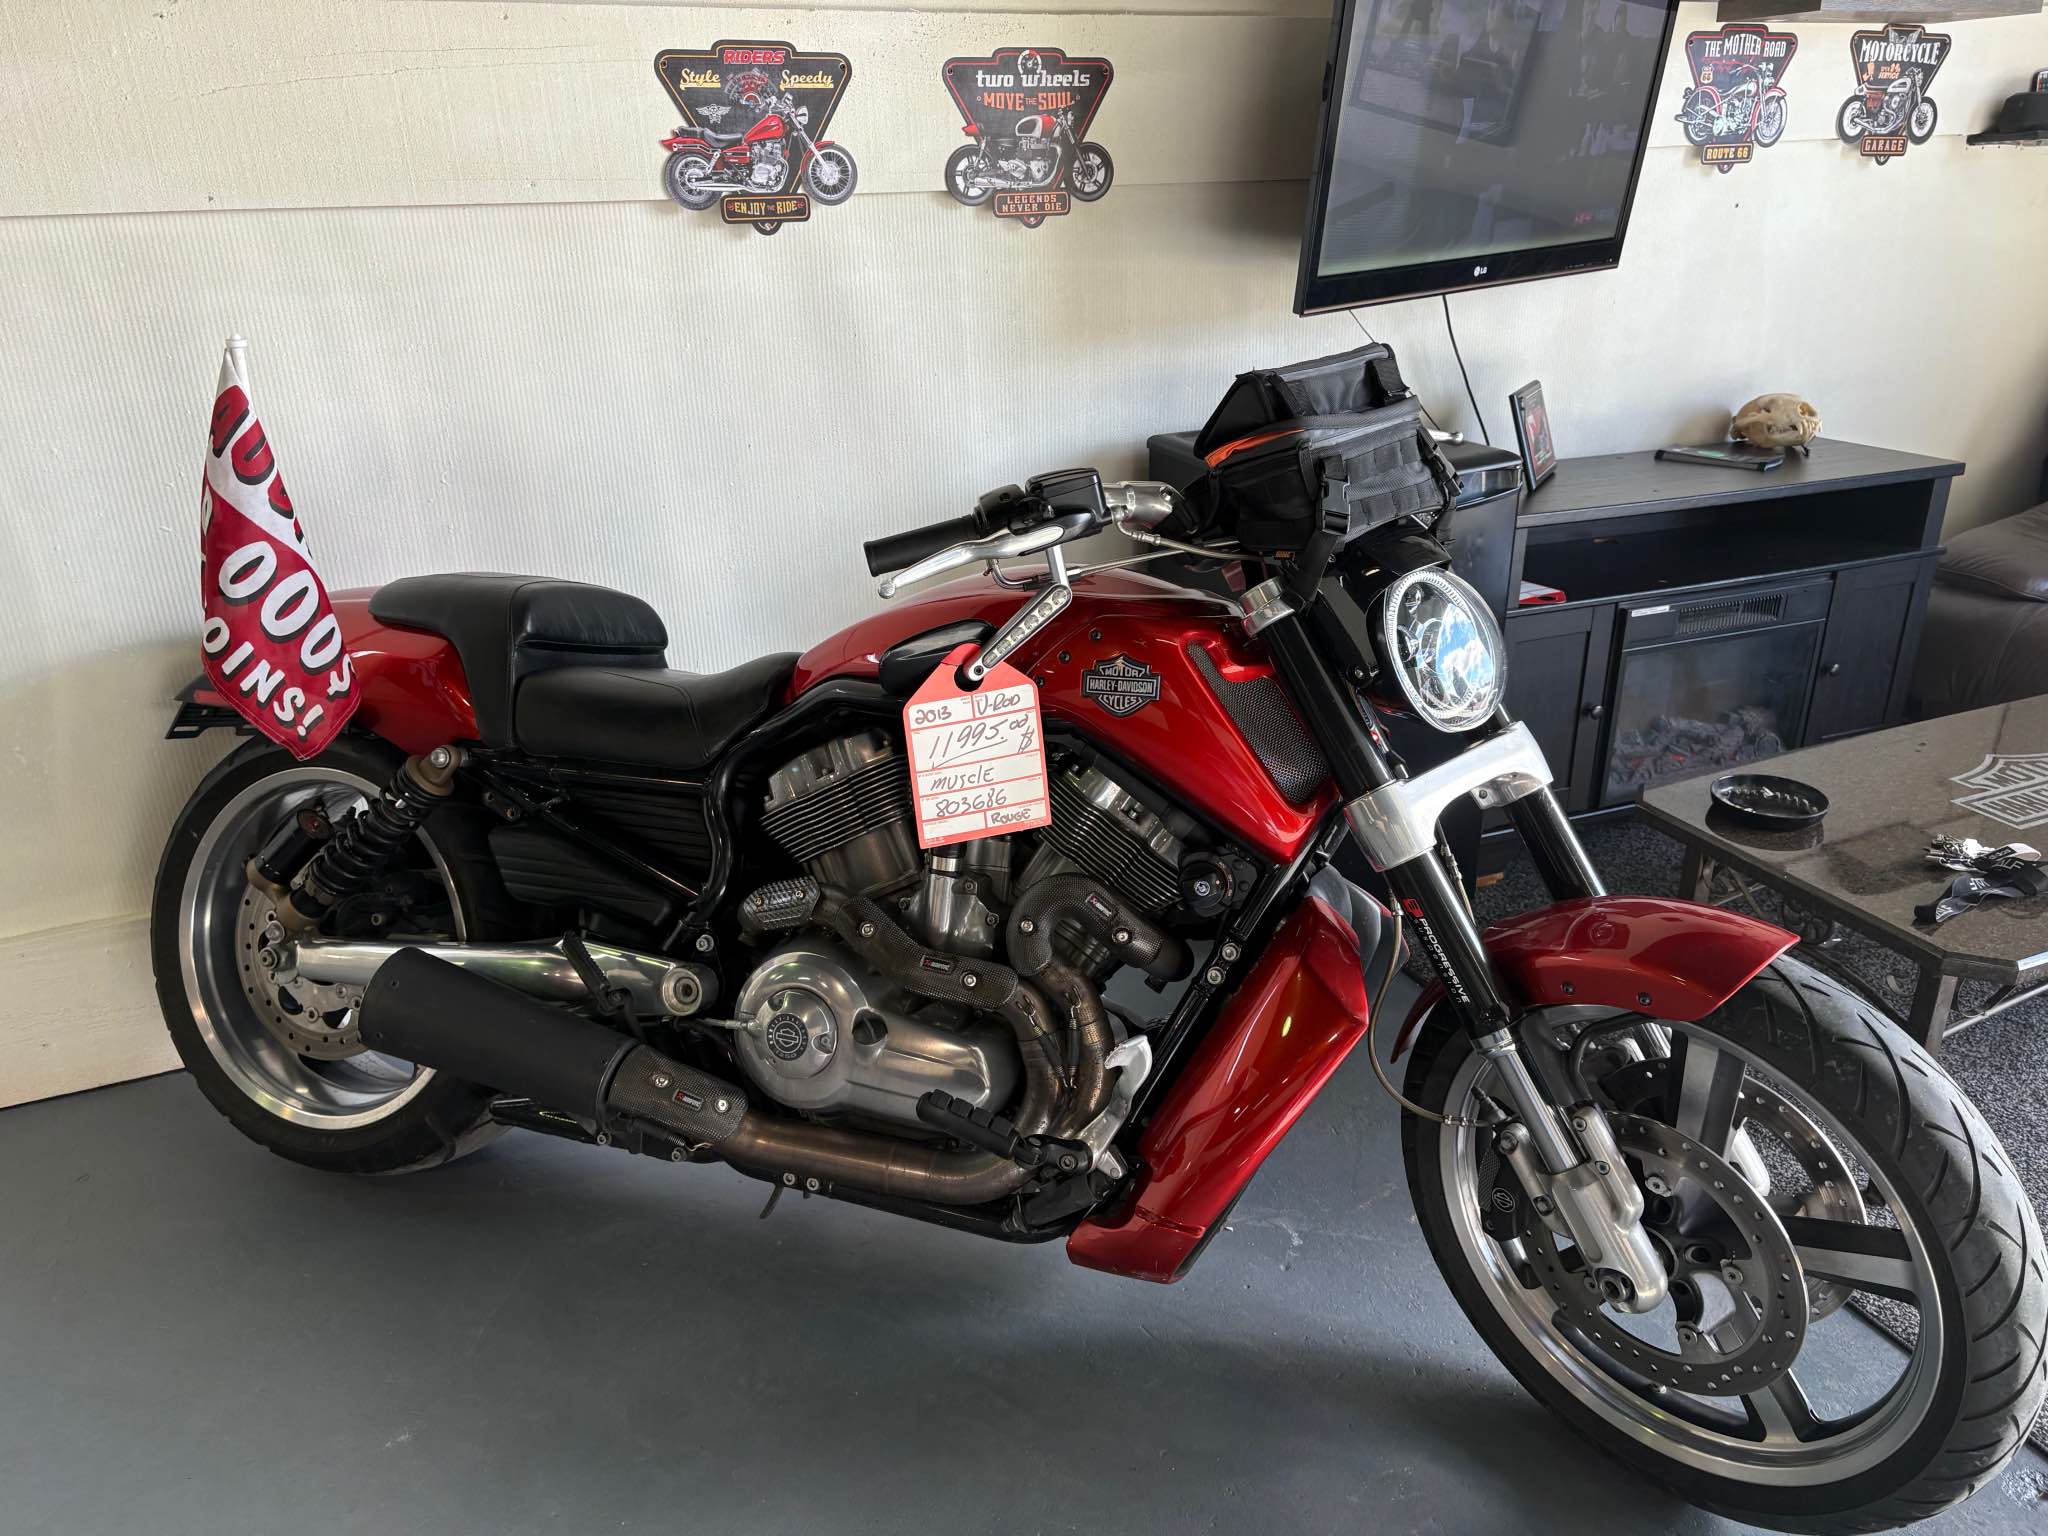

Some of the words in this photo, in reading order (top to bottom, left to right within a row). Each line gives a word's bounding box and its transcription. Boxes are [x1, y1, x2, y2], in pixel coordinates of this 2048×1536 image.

[1704, 40, 1723, 58] THE
[1723, 33, 1762, 56] MOTHER
[1763, 41, 1787, 58] ROAD
[1859, 39, 1941, 65] MOTORCYCLE
[723, 49, 785, 65] RIDERS
[680, 68, 721, 86] Style
[780, 69, 834, 87] Speedy
[976, 69, 1014, 88] two
[1020, 69, 1091, 87] wheels
[983, 92, 1025, 111] MOVE
[1025, 97, 1037, 105] THE
[1037, 91, 1073, 111] SOUL
[1706, 148, 1735, 159] ROUTE
[1736, 147, 1748, 158] 66
[1864, 139, 1904, 151] GARAGE
[734, 201, 766, 215] ENJOY
[776, 200, 798, 214] RIDE
[1007, 194, 1057, 204] LEGENDS
[1002, 203, 1038, 213] NEVER
[1044, 203, 1062, 211] DIE
[203, 616, 325, 738] OINS!
[1105, 664, 1140, 678] MOTOR
[1089, 678, 1153, 694] HARLEY-DAVIDSON
[1103, 694, 1137, 710] CYCLES
[914, 705, 952, 725] 2013
[935, 788, 1007, 818] 803686
[990, 808, 1031, 825] ROUGE
[1419, 918, 1470, 1003] PROGRESSIVE
